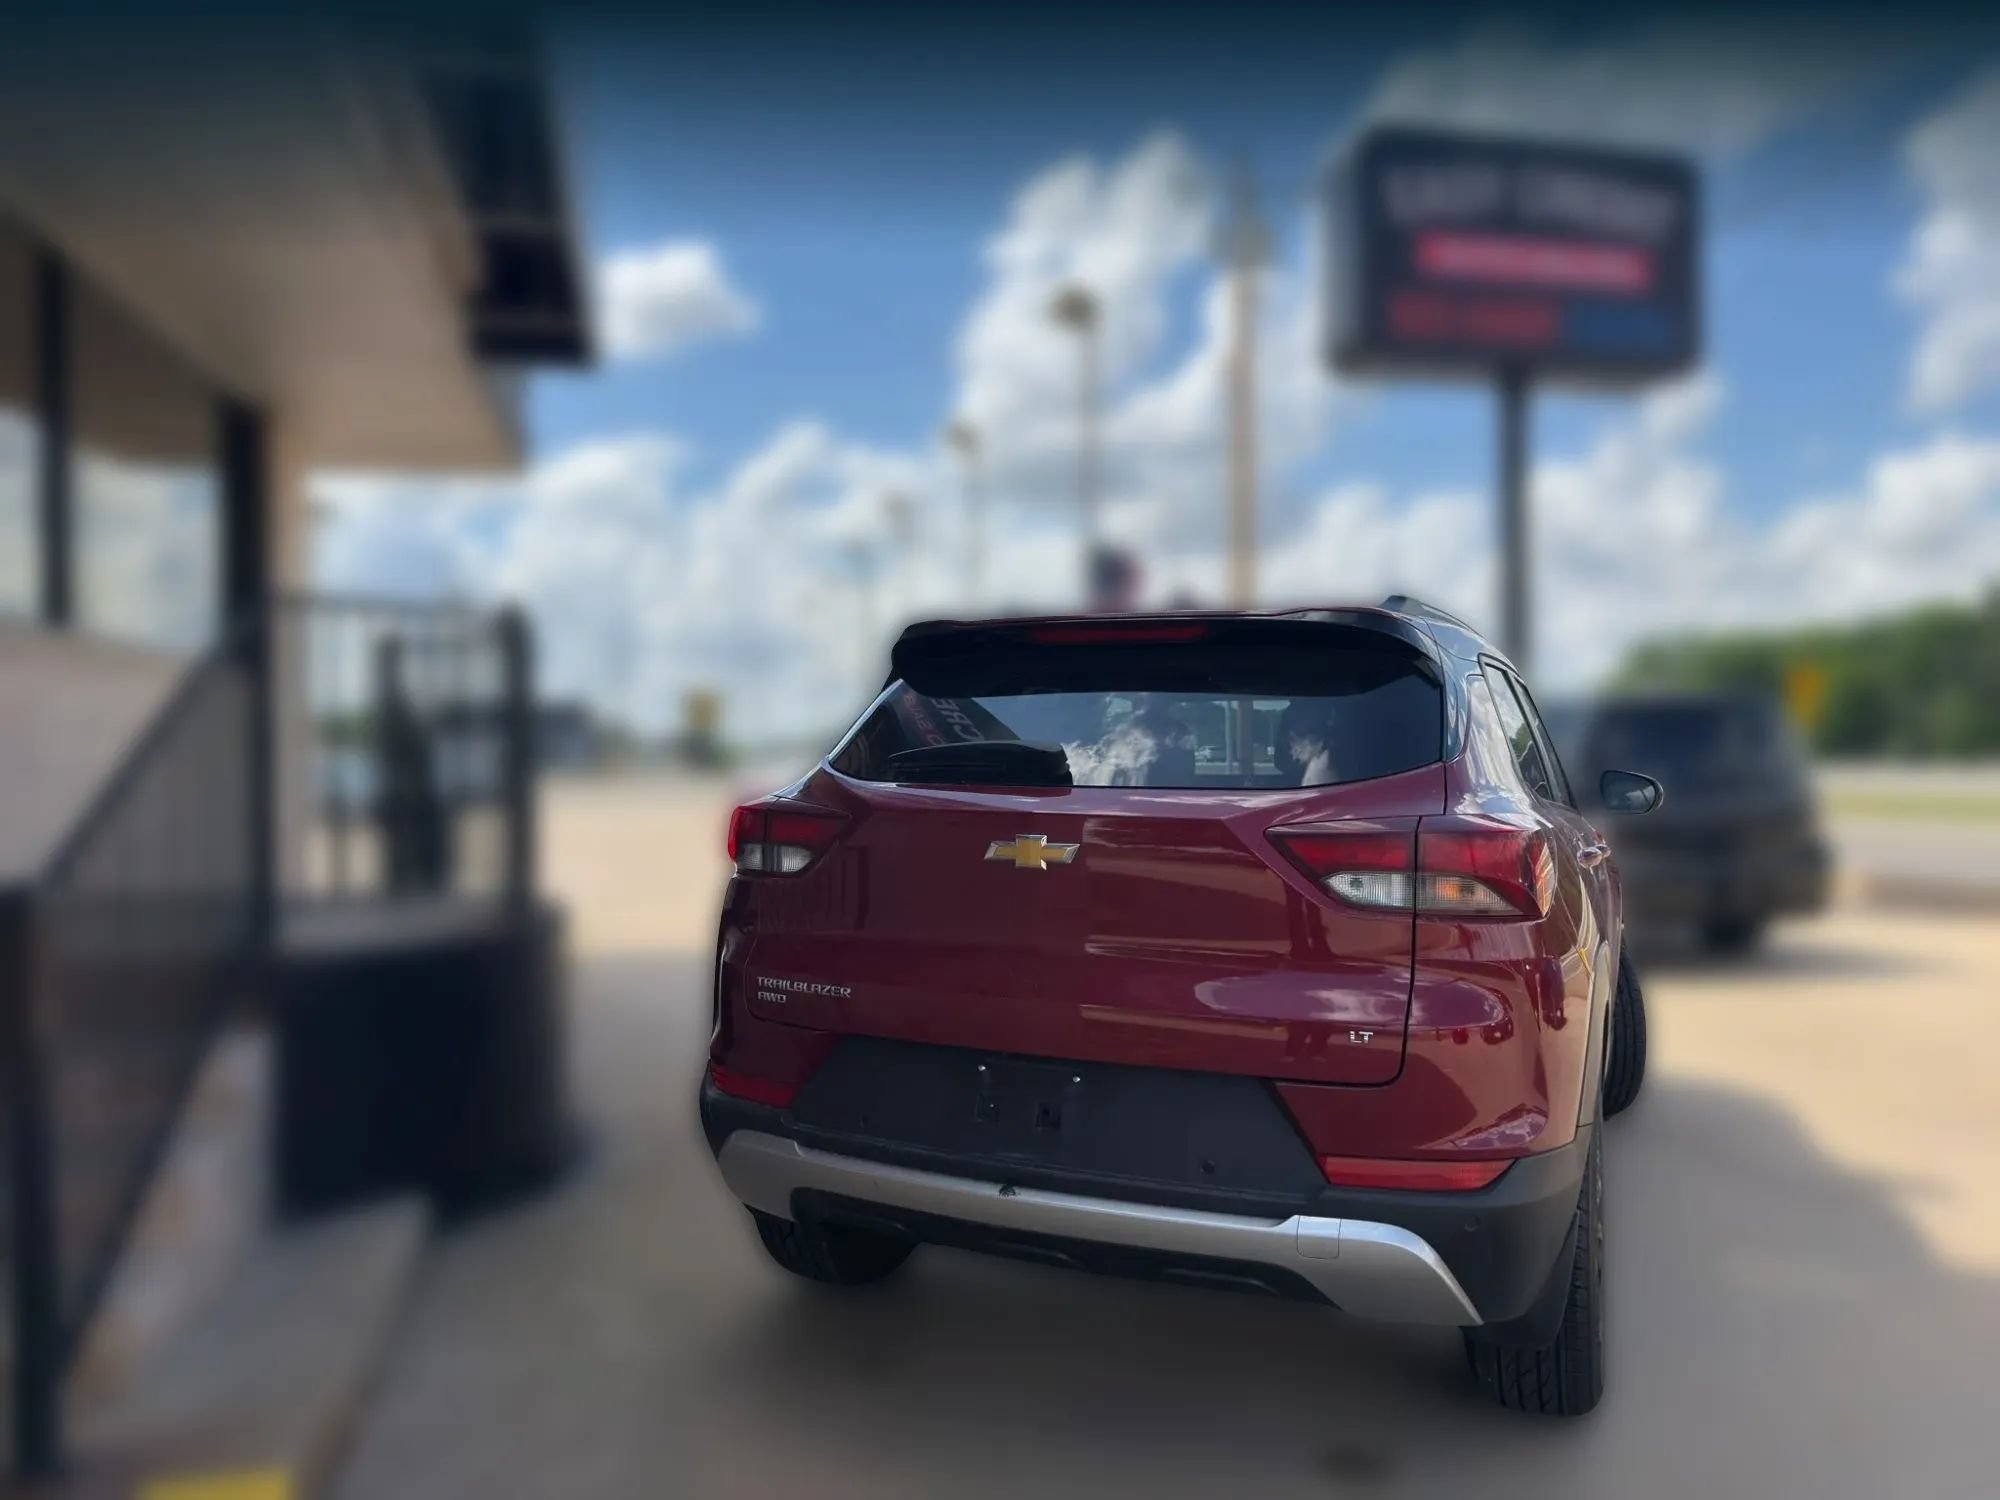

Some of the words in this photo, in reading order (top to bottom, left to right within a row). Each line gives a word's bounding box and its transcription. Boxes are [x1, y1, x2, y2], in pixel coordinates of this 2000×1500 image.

[757, 976, 852, 998] TRAILBLAZER
[757, 991, 787, 1004] AWD
[1349, 1031, 1374, 1044] LT
